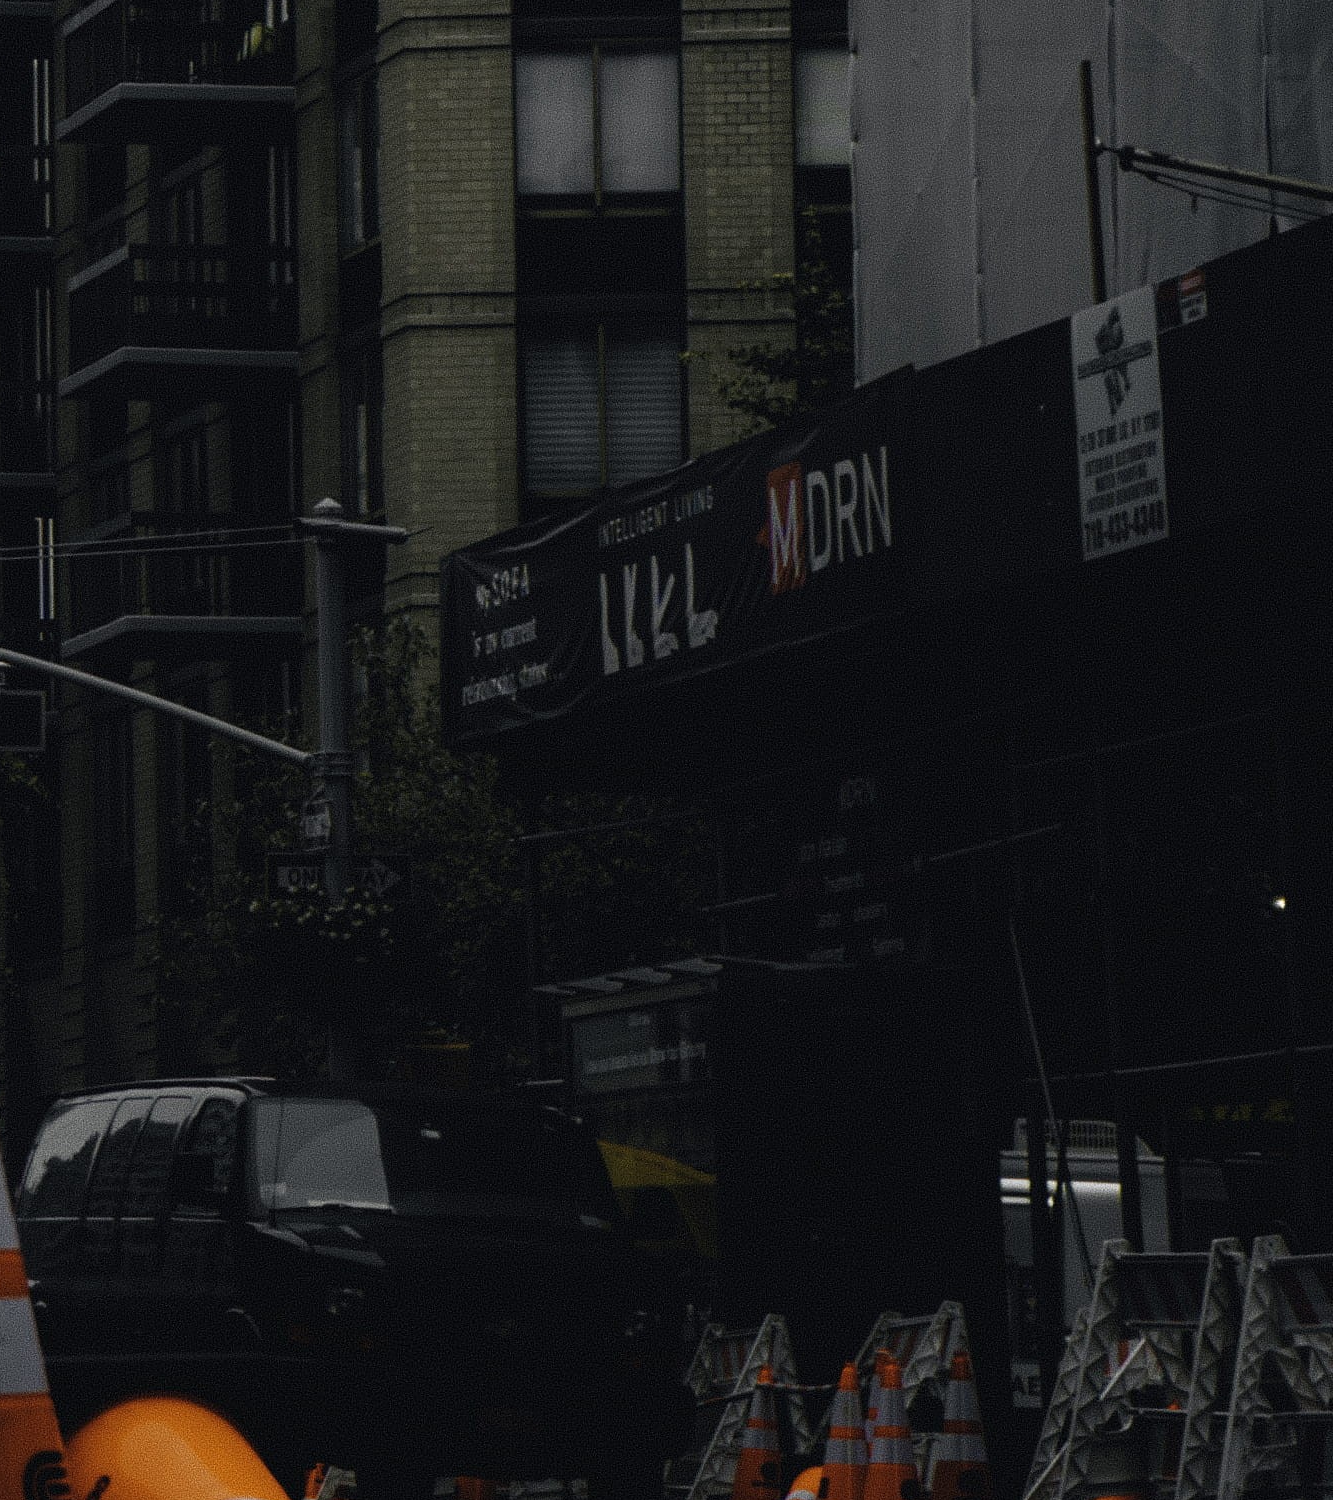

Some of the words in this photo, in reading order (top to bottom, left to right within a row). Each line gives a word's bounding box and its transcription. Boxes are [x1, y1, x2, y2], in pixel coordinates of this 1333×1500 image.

[598, 501, 668, 548] INTELLIGENT
[674, 485, 714, 523] LIVING
[769, 445, 893, 586] MDRN
